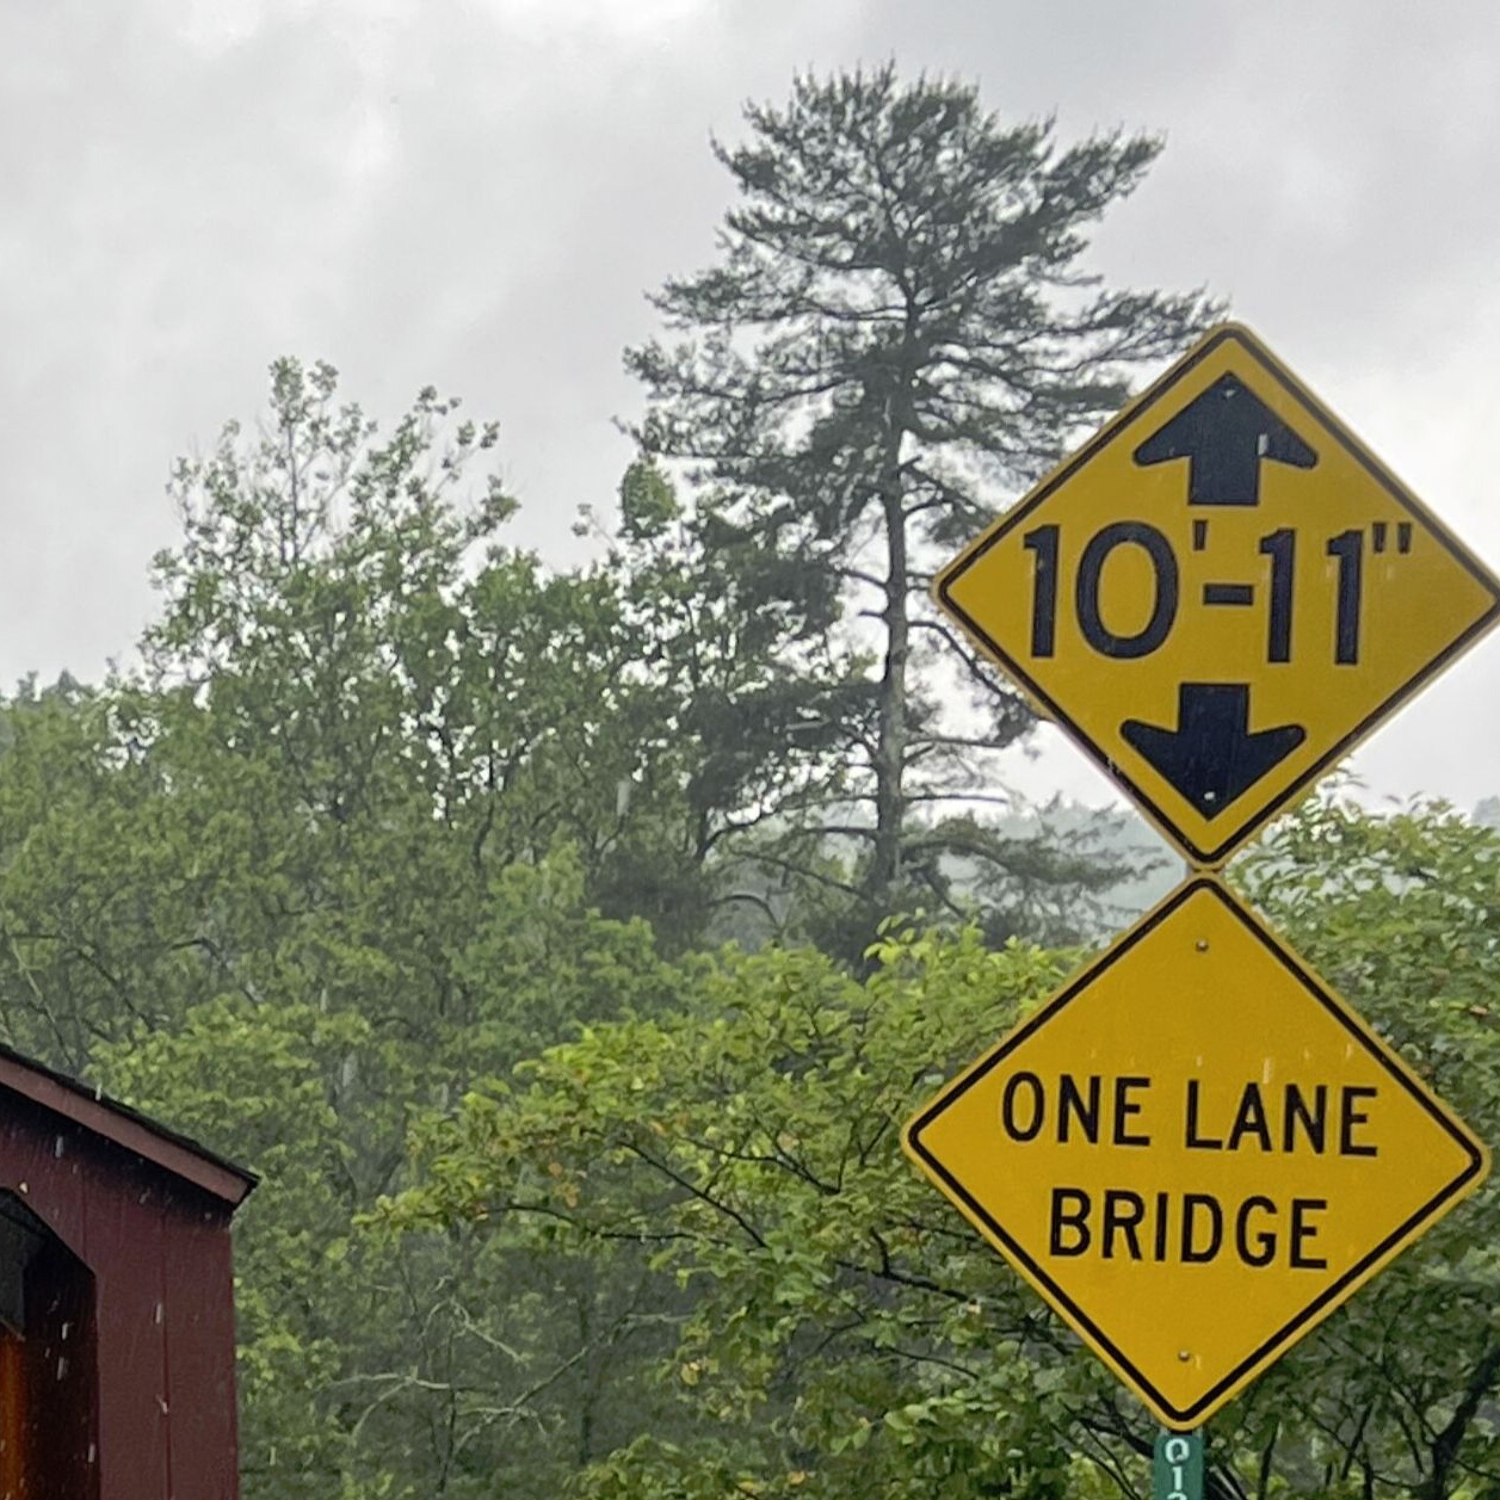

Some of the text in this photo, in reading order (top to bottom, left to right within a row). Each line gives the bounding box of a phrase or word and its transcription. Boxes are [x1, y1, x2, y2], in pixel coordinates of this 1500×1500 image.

[1023, 519, 1412, 665] 10'-11"
[1002, 1071, 1379, 1157] ONE LANE
[1048, 1187, 1329, 1270] BRIDGE
